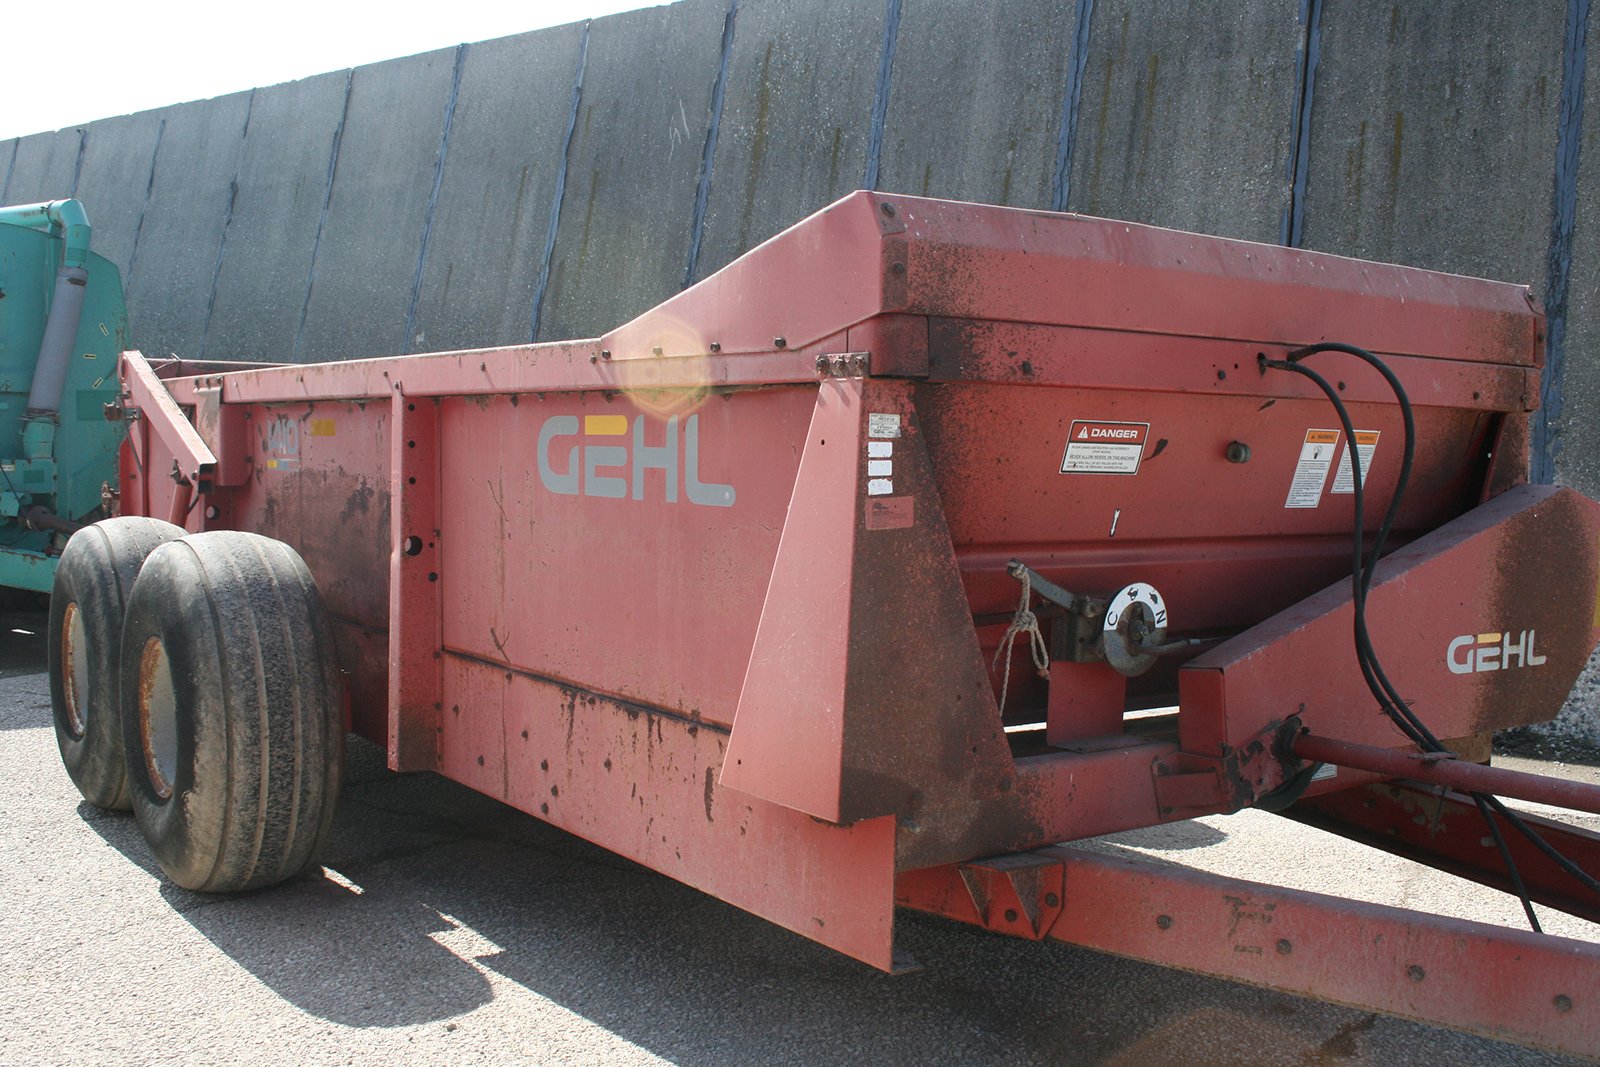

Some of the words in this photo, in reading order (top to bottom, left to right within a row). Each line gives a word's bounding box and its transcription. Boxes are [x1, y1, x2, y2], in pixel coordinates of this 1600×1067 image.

[1091, 428, 1138, 439] DANGER
[537, 414, 736, 507] GEHL
[1447, 629, 1547, 674] GEHL
